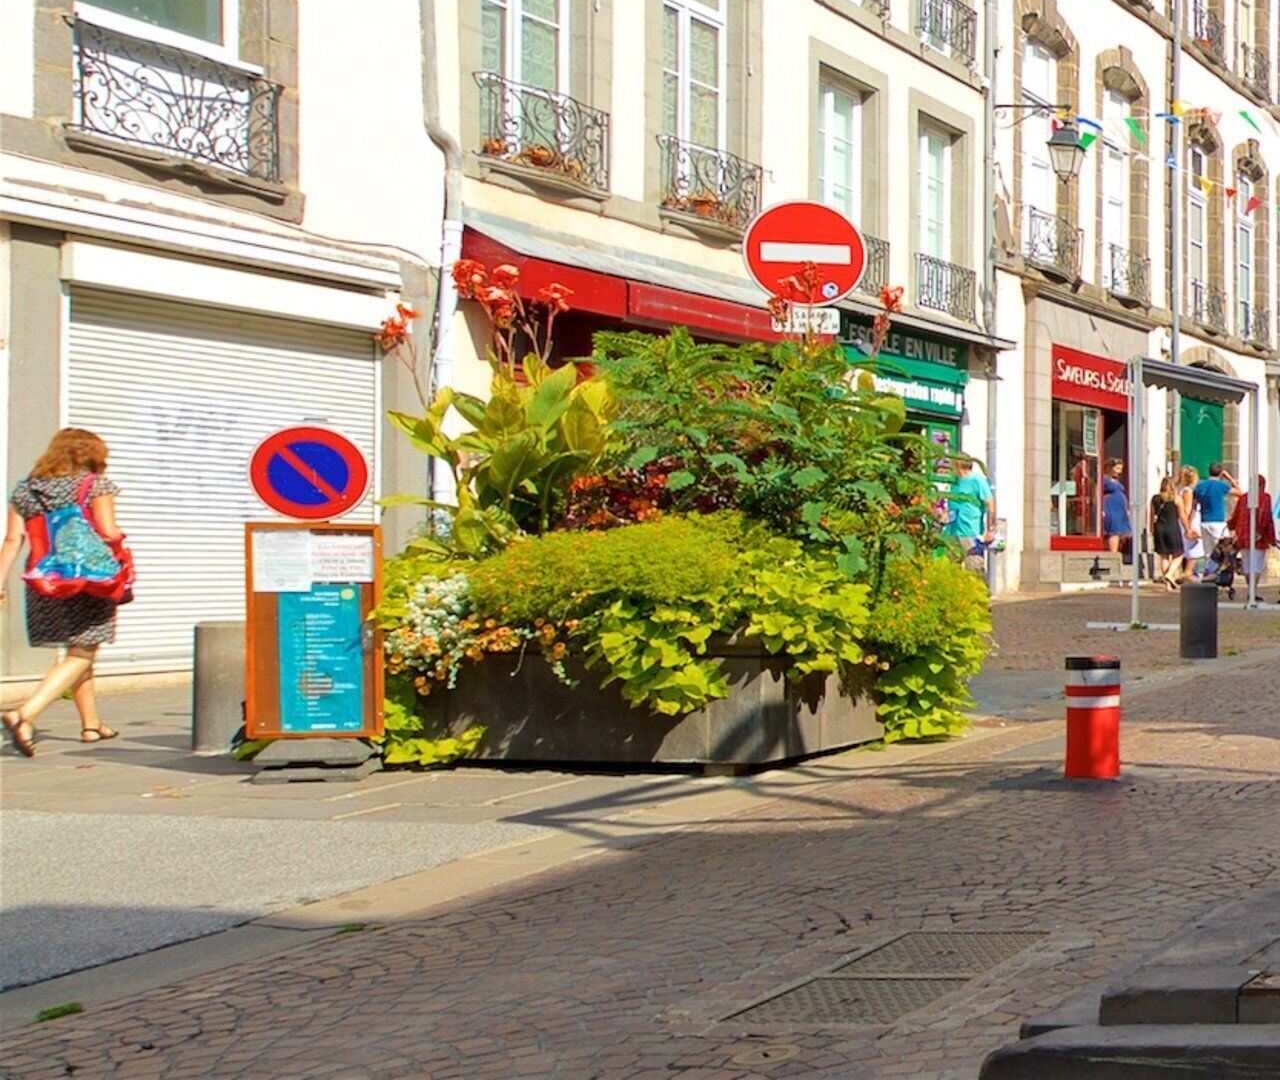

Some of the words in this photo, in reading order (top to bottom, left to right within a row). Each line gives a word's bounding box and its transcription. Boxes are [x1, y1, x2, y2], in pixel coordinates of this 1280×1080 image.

[905, 334, 921, 359] EN
[923, 339, 957, 367] VILLE
[1057, 359, 1100, 389] SAVEURS
